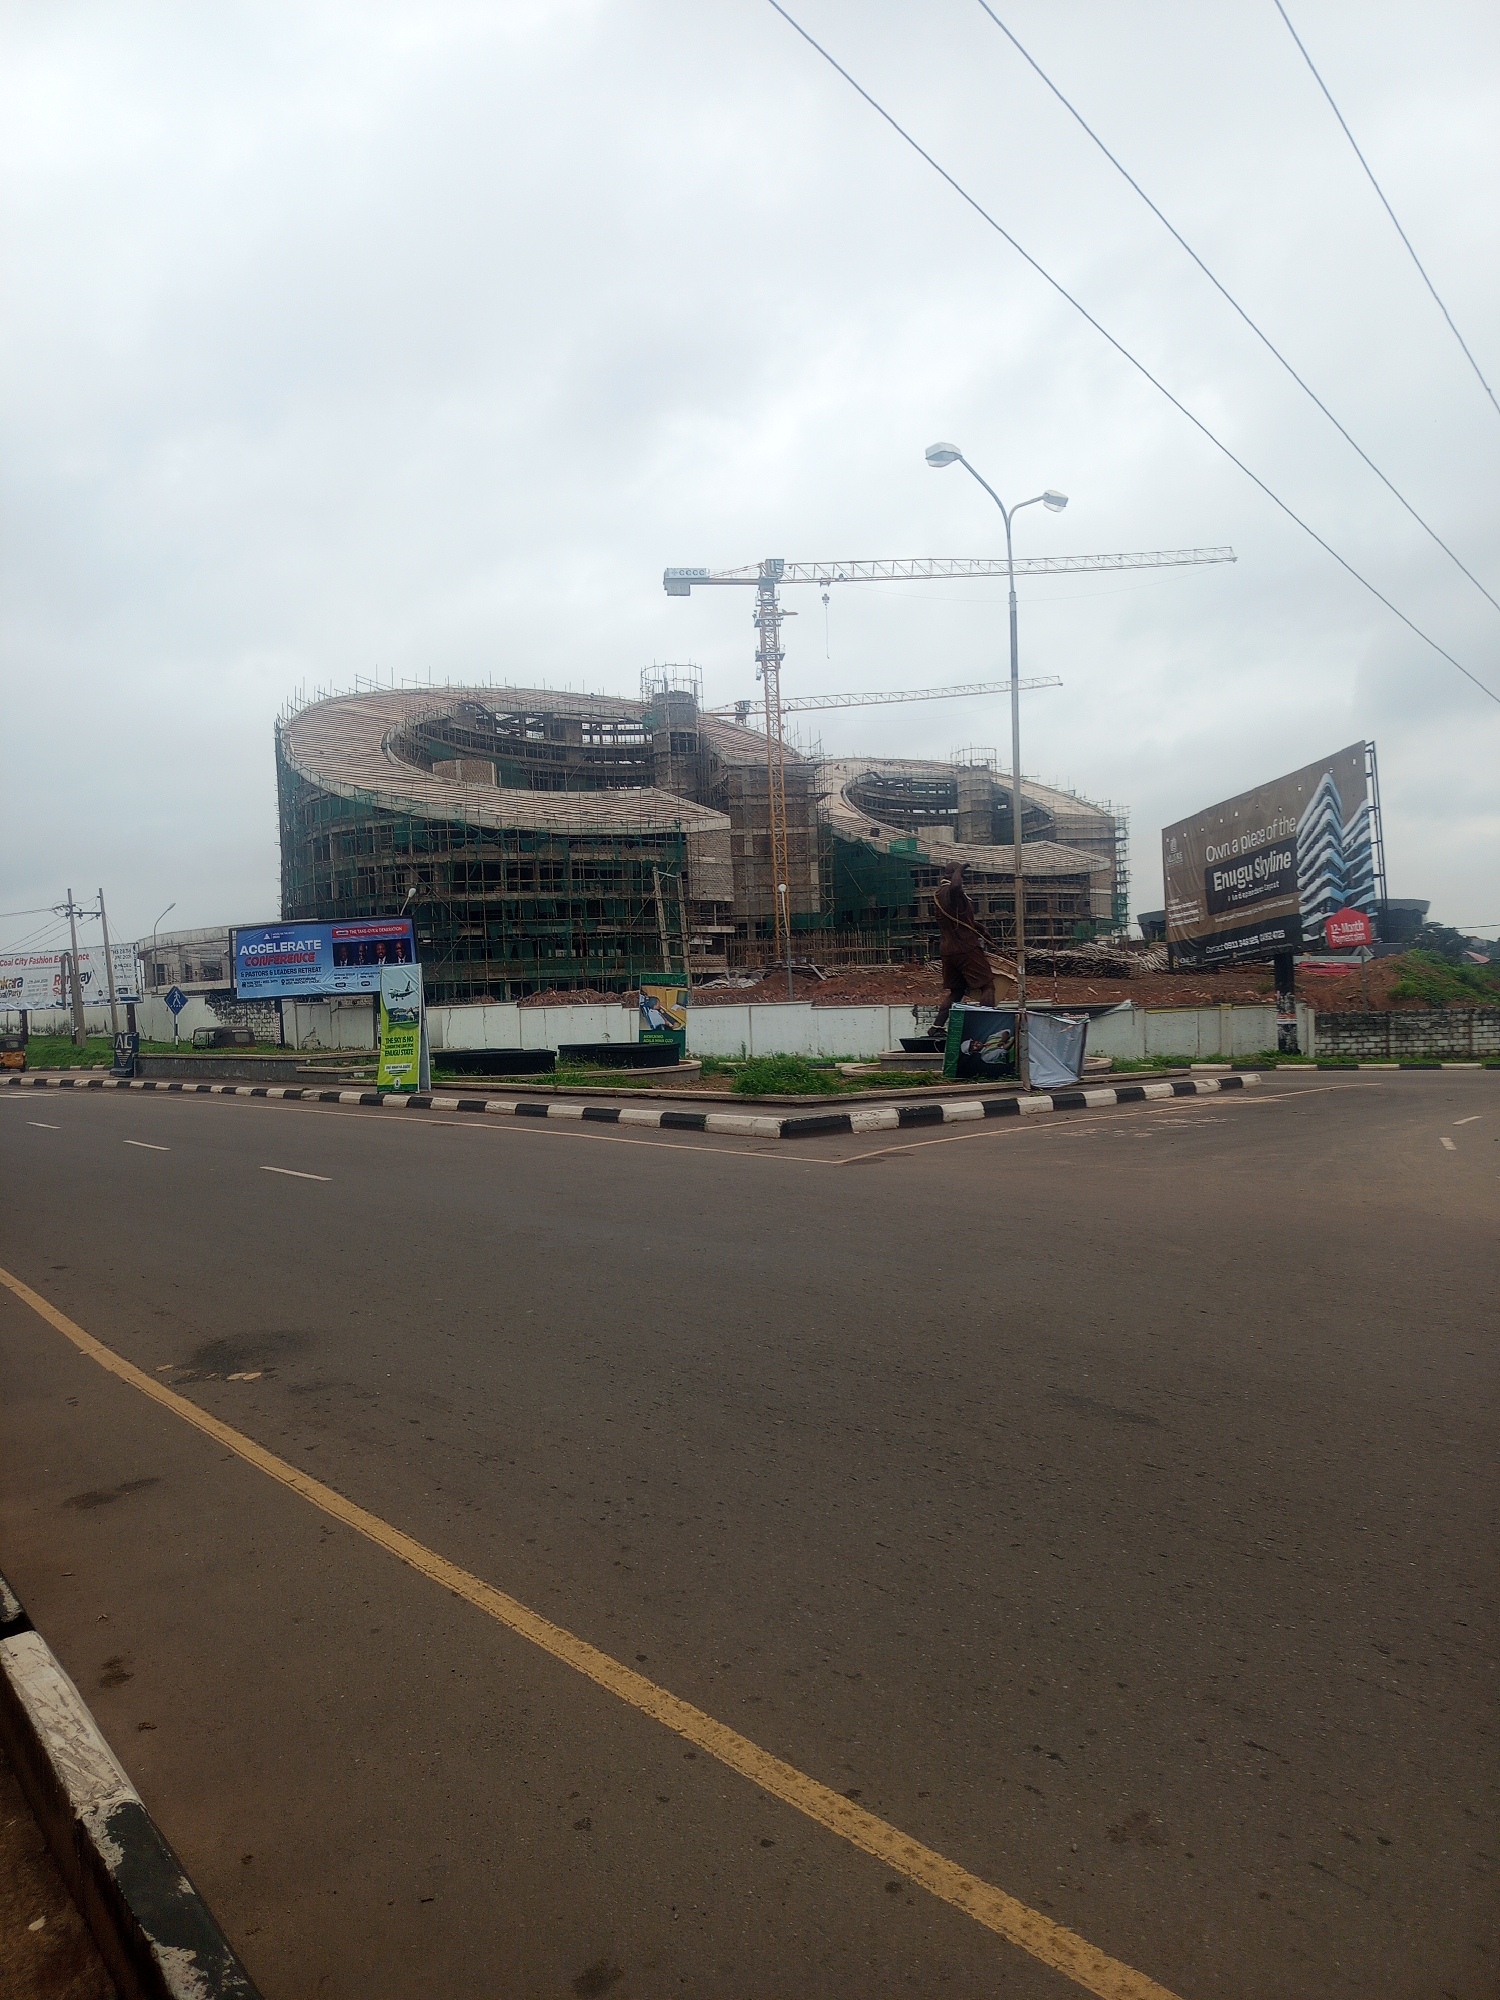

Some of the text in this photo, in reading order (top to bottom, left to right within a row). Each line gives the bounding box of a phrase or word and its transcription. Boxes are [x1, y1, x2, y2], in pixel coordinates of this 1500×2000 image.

[1206, 816, 1297, 862] Own a piece of the
[1214, 851, 1291, 891] Enugu Skyline
[239, 940, 322, 955] ACCELERATE
[0, 959, 13, 967] Coal
[14, 957, 29, 967] City
[28, 956, 53, 965] Fashion
[245, 952, 316, 967] CONFERENCE
[245, 970, 269, 978] PASTORS
[274, 968, 298, 976] LEADERS
[297, 966, 322, 975] RETREAT
[393, 1036, 402, 1044] SKY
[385, 1048, 414, 1057] ENUGU STATE
